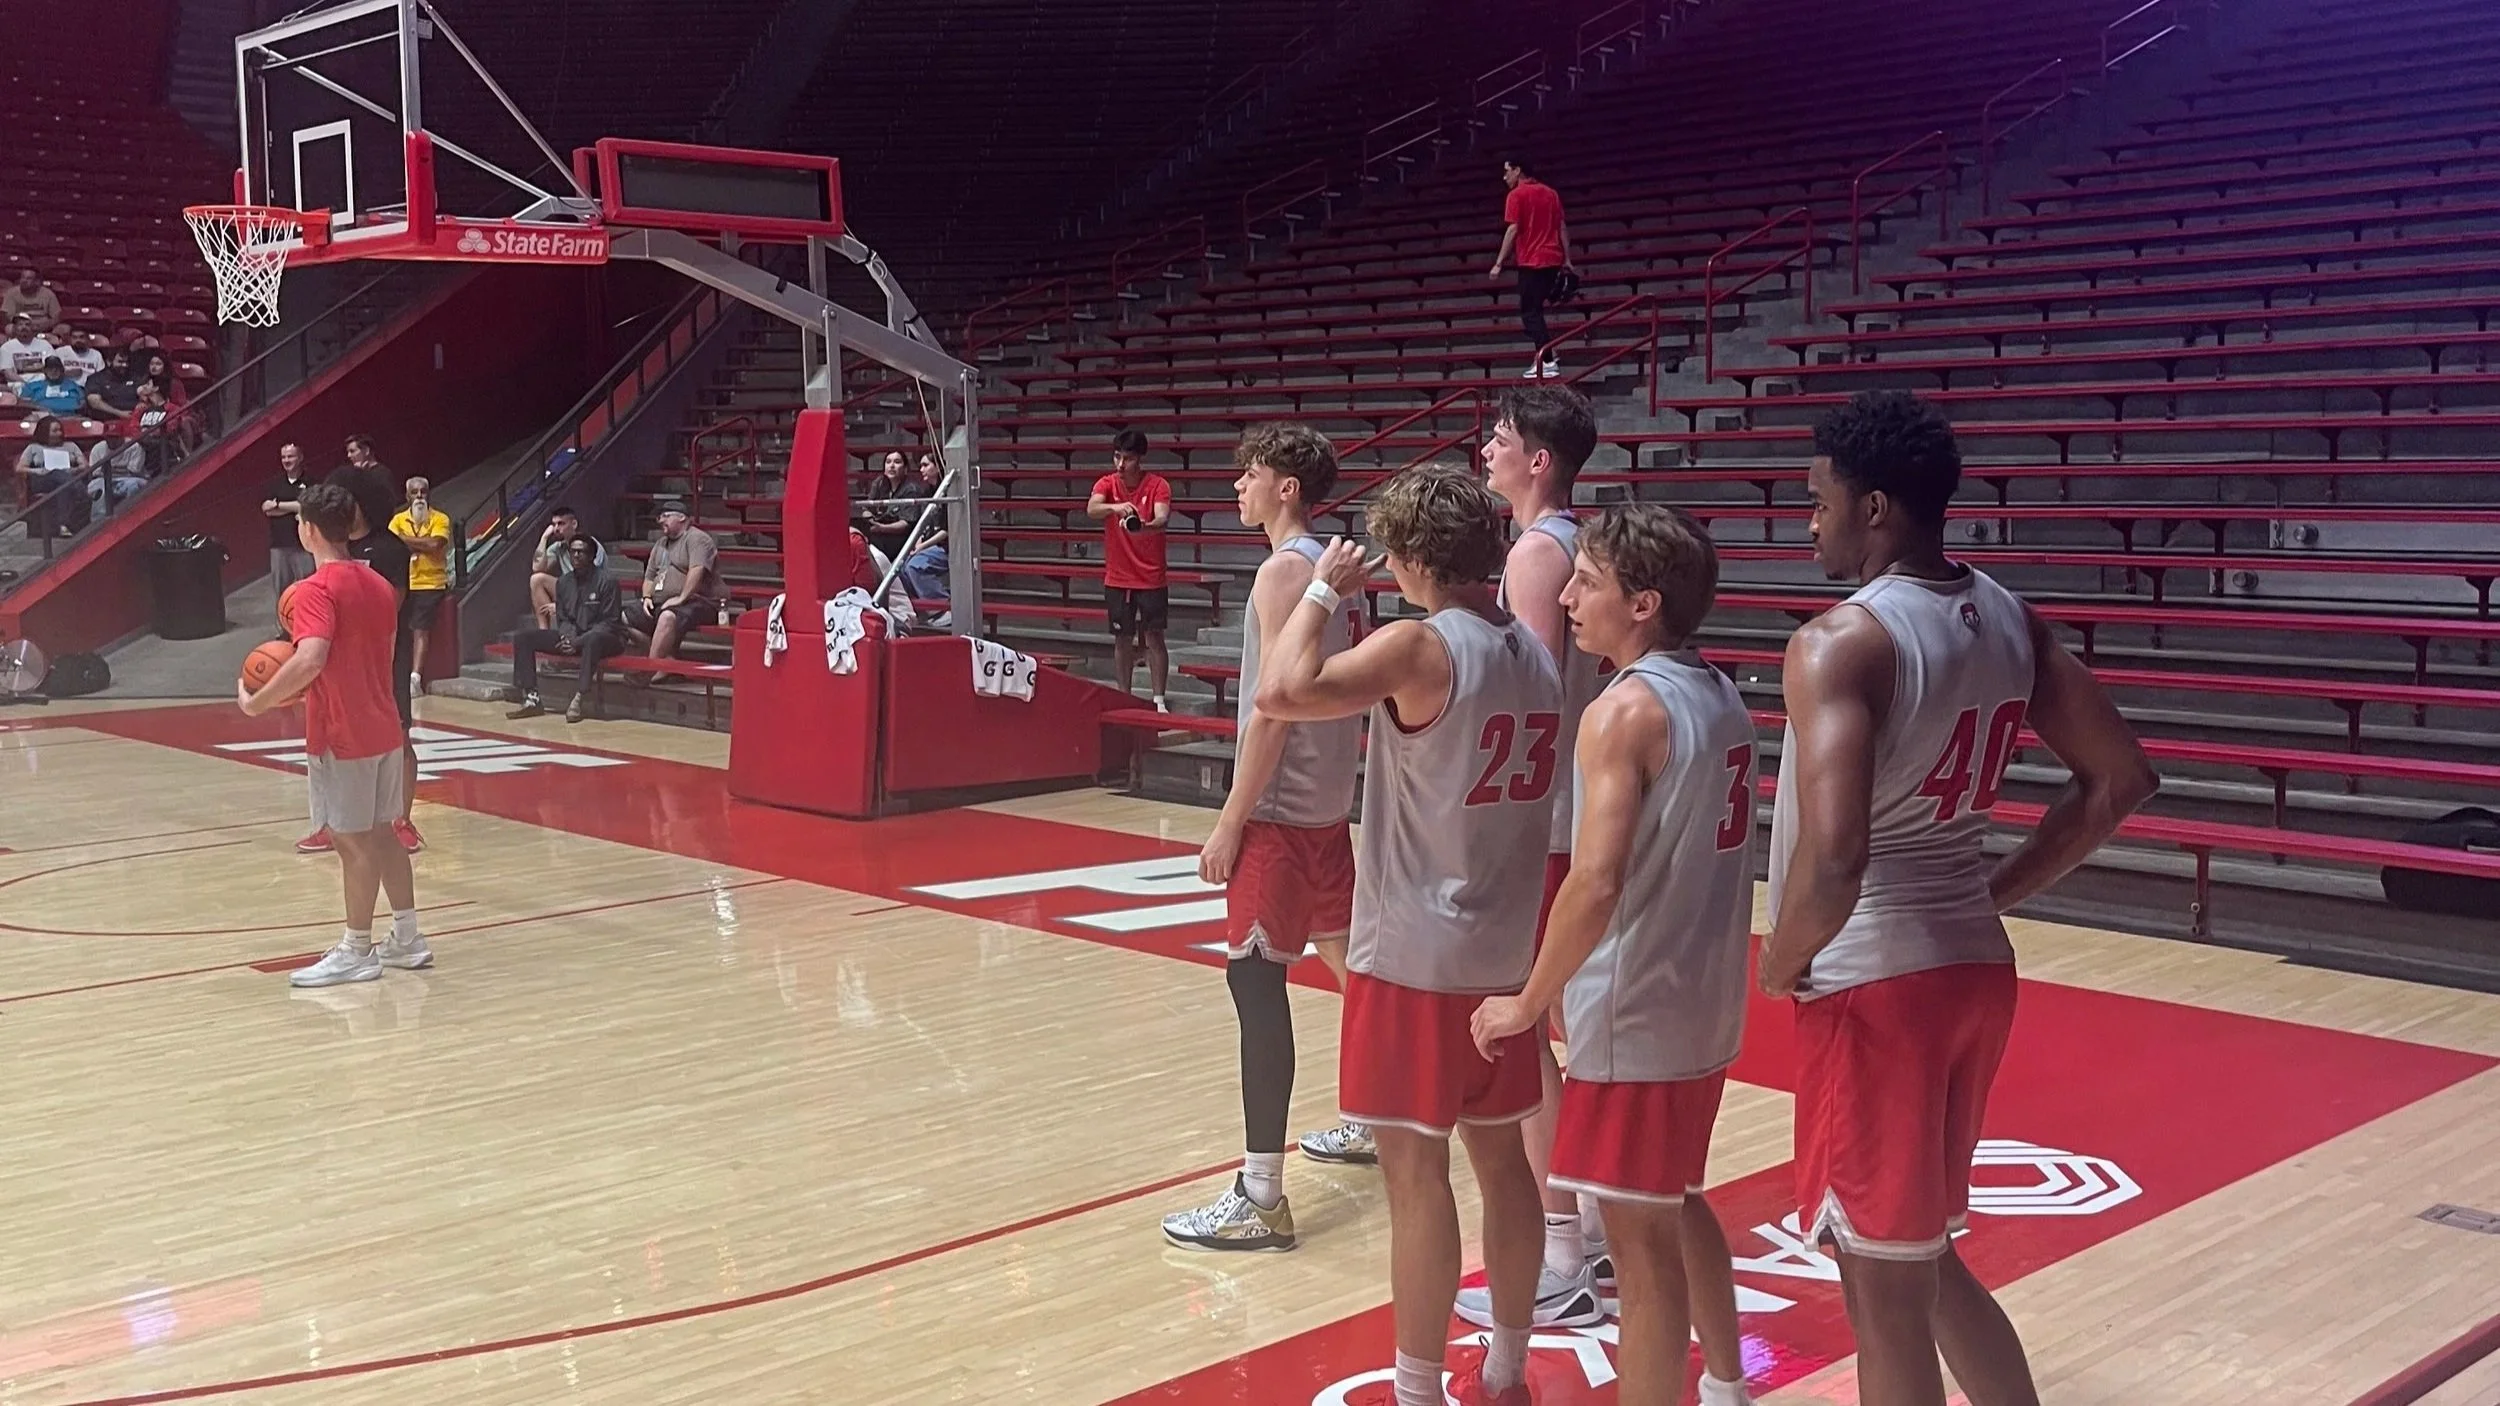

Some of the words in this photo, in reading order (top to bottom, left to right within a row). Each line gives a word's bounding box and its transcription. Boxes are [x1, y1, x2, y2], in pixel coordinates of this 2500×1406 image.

[1462, 710, 1561, 808] 23
[1715, 741, 1752, 853] 3
[1912, 697, 2028, 824] 40
